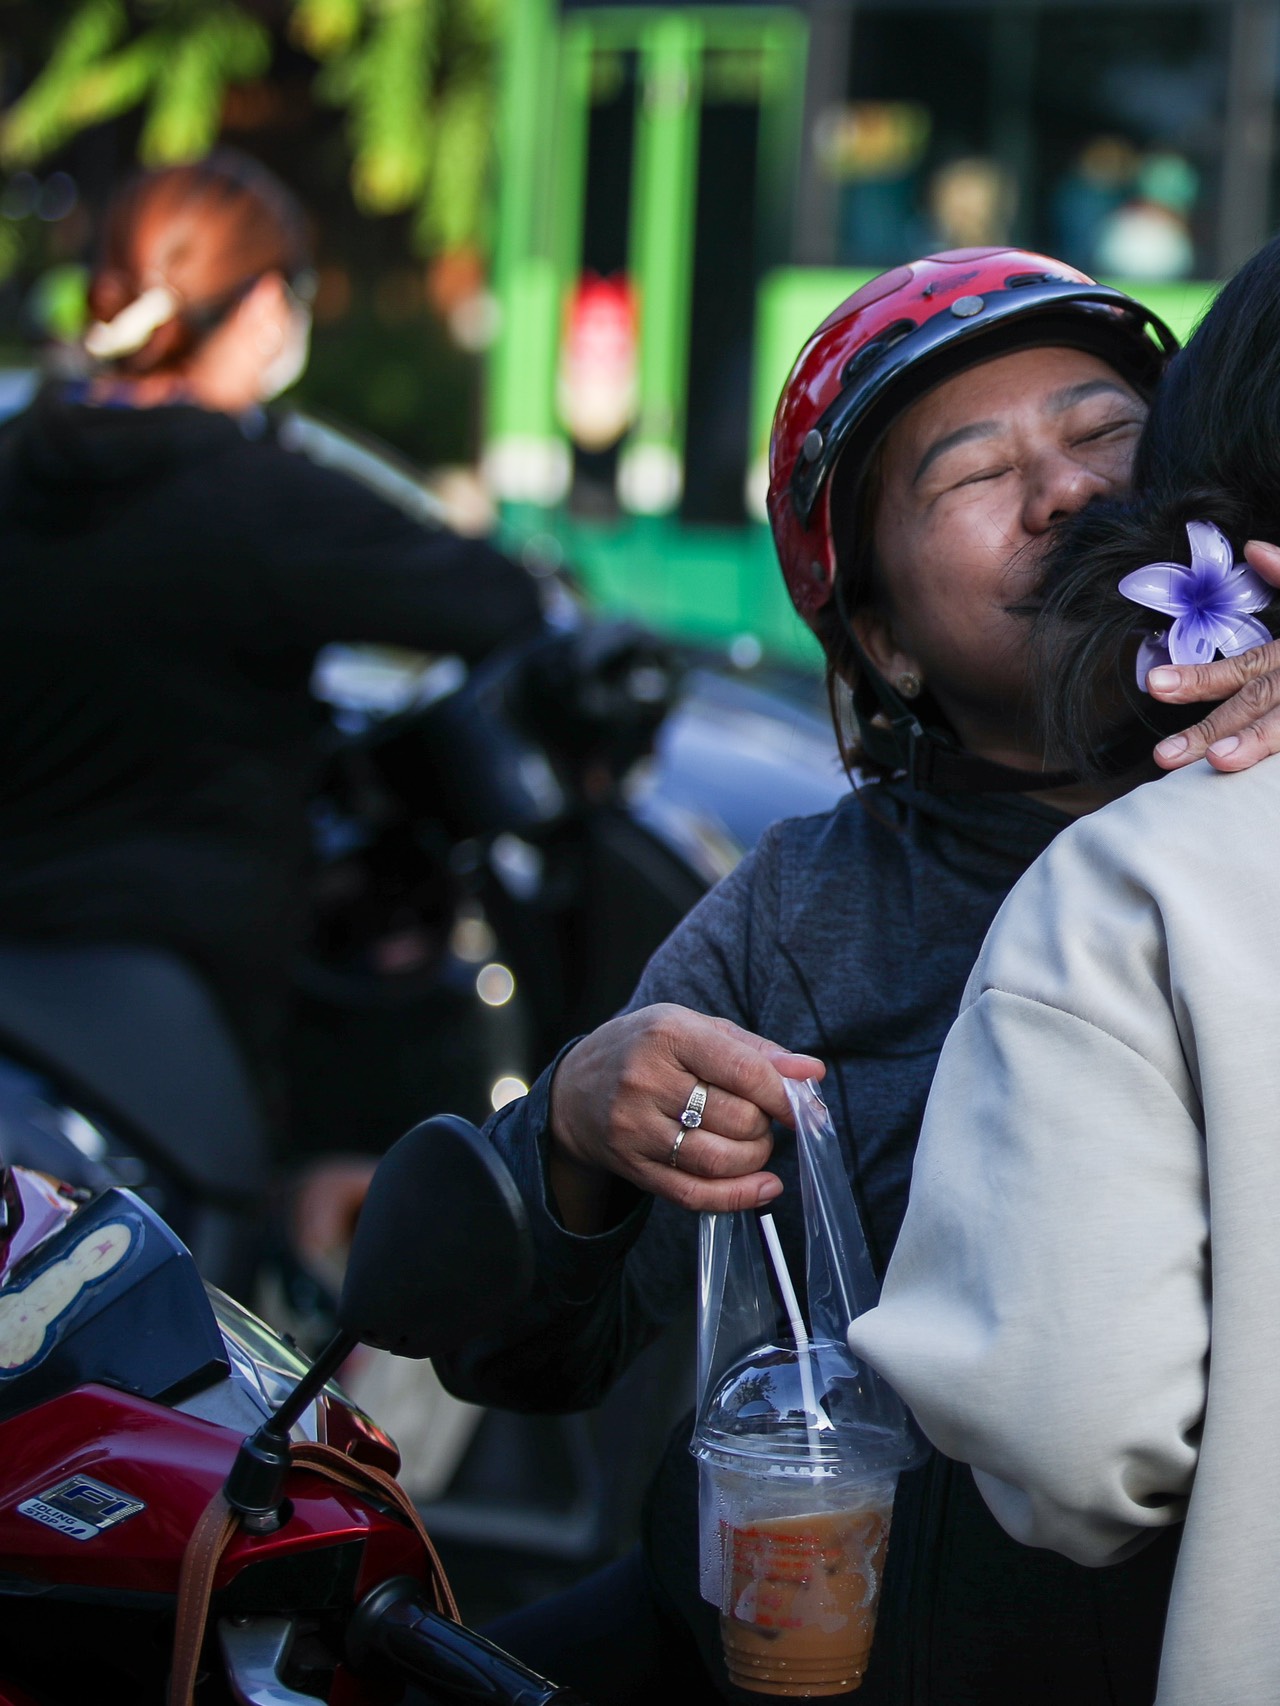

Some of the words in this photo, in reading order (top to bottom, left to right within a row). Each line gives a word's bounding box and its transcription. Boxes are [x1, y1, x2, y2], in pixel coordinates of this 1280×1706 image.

[61, 1484, 132, 1516] FI
[23, 1507, 59, 1525] STOP
[32, 1502, 78, 1525] IDLING
